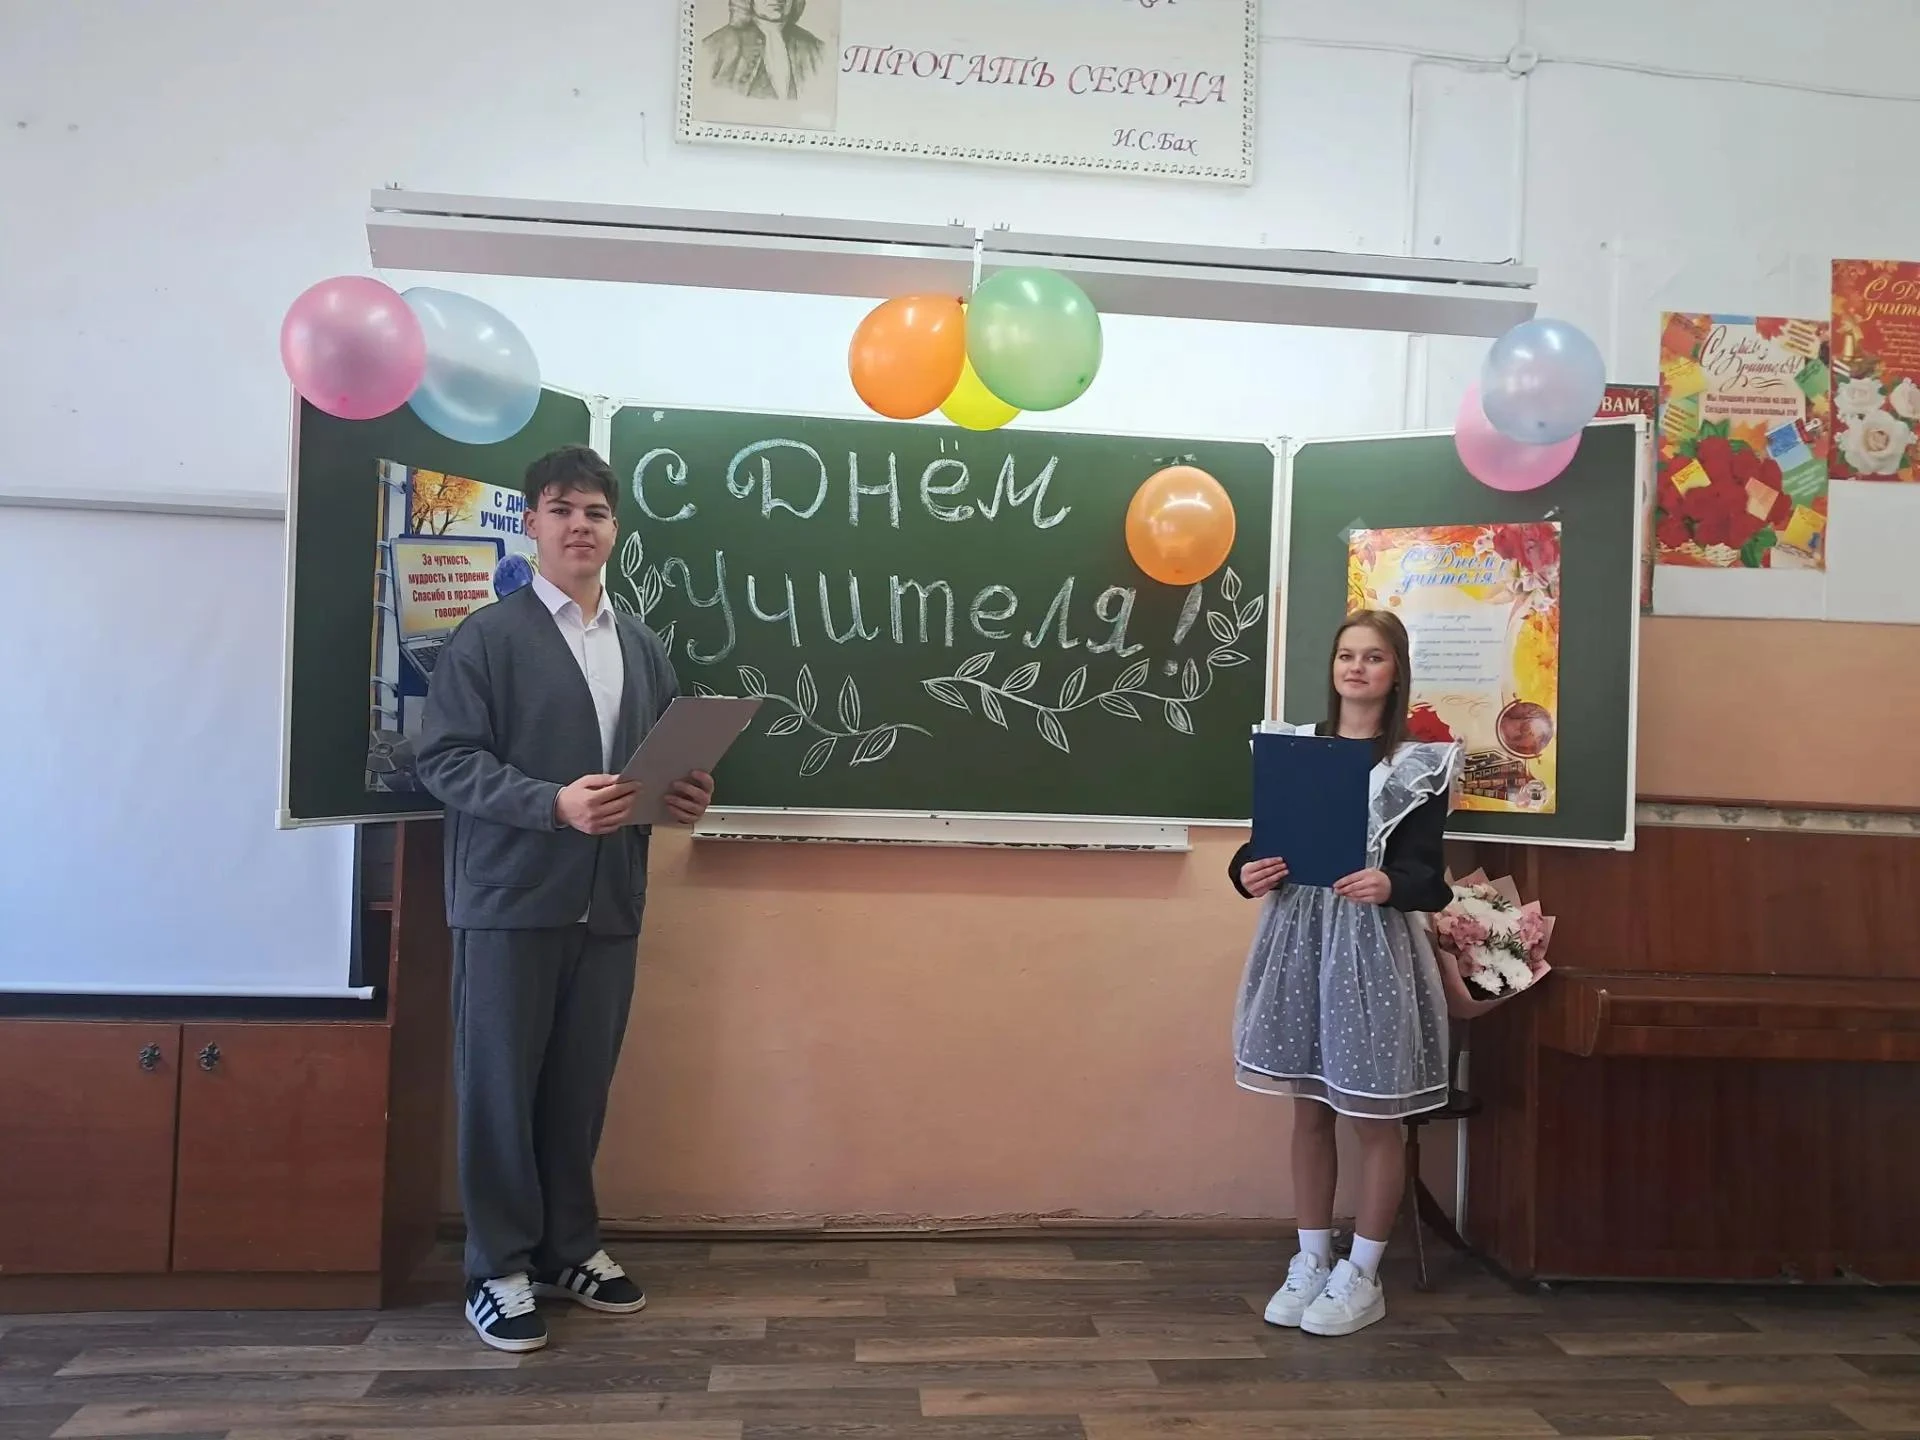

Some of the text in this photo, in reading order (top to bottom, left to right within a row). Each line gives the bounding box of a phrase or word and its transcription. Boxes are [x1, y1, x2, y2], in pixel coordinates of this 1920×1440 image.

[842, 44, 1227, 107] ТРОГАТЬ СЕРДЦА
[422, 553, 433, 566] За
[408, 571, 490, 585] мудрость и терпение
[412, 588, 489, 602] Спасибо в праздник
